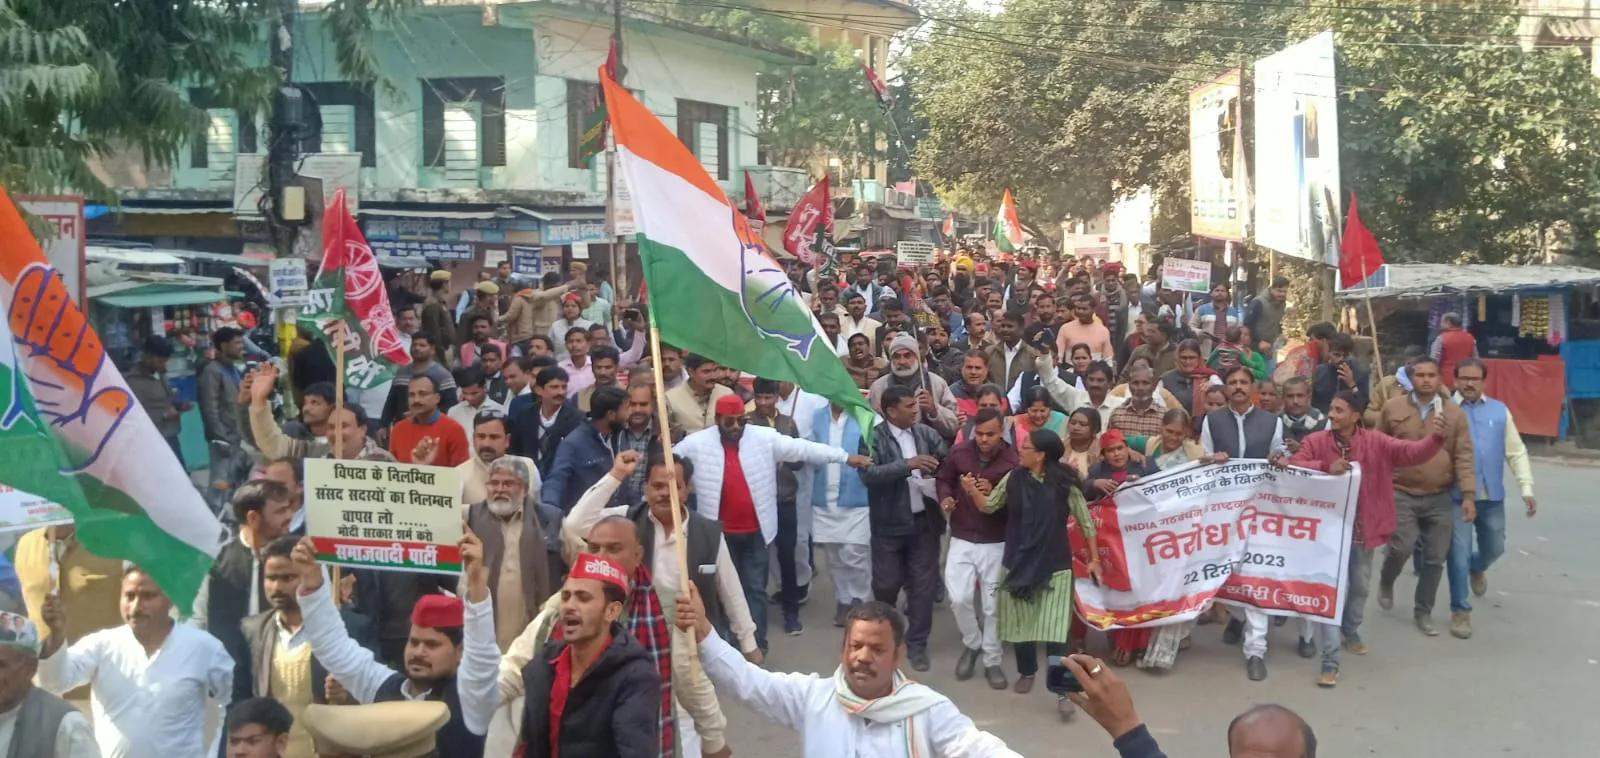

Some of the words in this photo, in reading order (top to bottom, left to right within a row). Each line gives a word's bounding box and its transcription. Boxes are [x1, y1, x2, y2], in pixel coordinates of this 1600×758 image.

[334, 463, 366, 480] विपक्ष
[371, 465, 383, 481] के
[387, 467, 435, 485] निलम्बित
[1141, 474, 1193, 496] लोकसभा
[1203, 462, 1257, 478] राज्यसभा
[1219, 476, 1231, 487] के
[314, 484, 344, 501] संसद
[348, 486, 385, 503] सदस्यों
[389, 491, 405, 504] का
[409, 490, 453, 509] निलम्बन
[342, 509, 373, 524] वापस
[377, 508, 393, 525] लो
[1124, 521, 1158, 533] INDIA
[338, 524, 359, 537] मोदी
[363, 527, 393, 539] सरकार
[395, 527, 413, 540] शर्म
[416, 529, 433, 542] करो
[1143, 522, 1231, 566] विरोध
[334, 542, 404, 564] समाजवादी
[408, 543, 438, 567] पार्टी
[1183, 571, 1200, 586] 22
[1243, 552, 1285, 567] 2023
